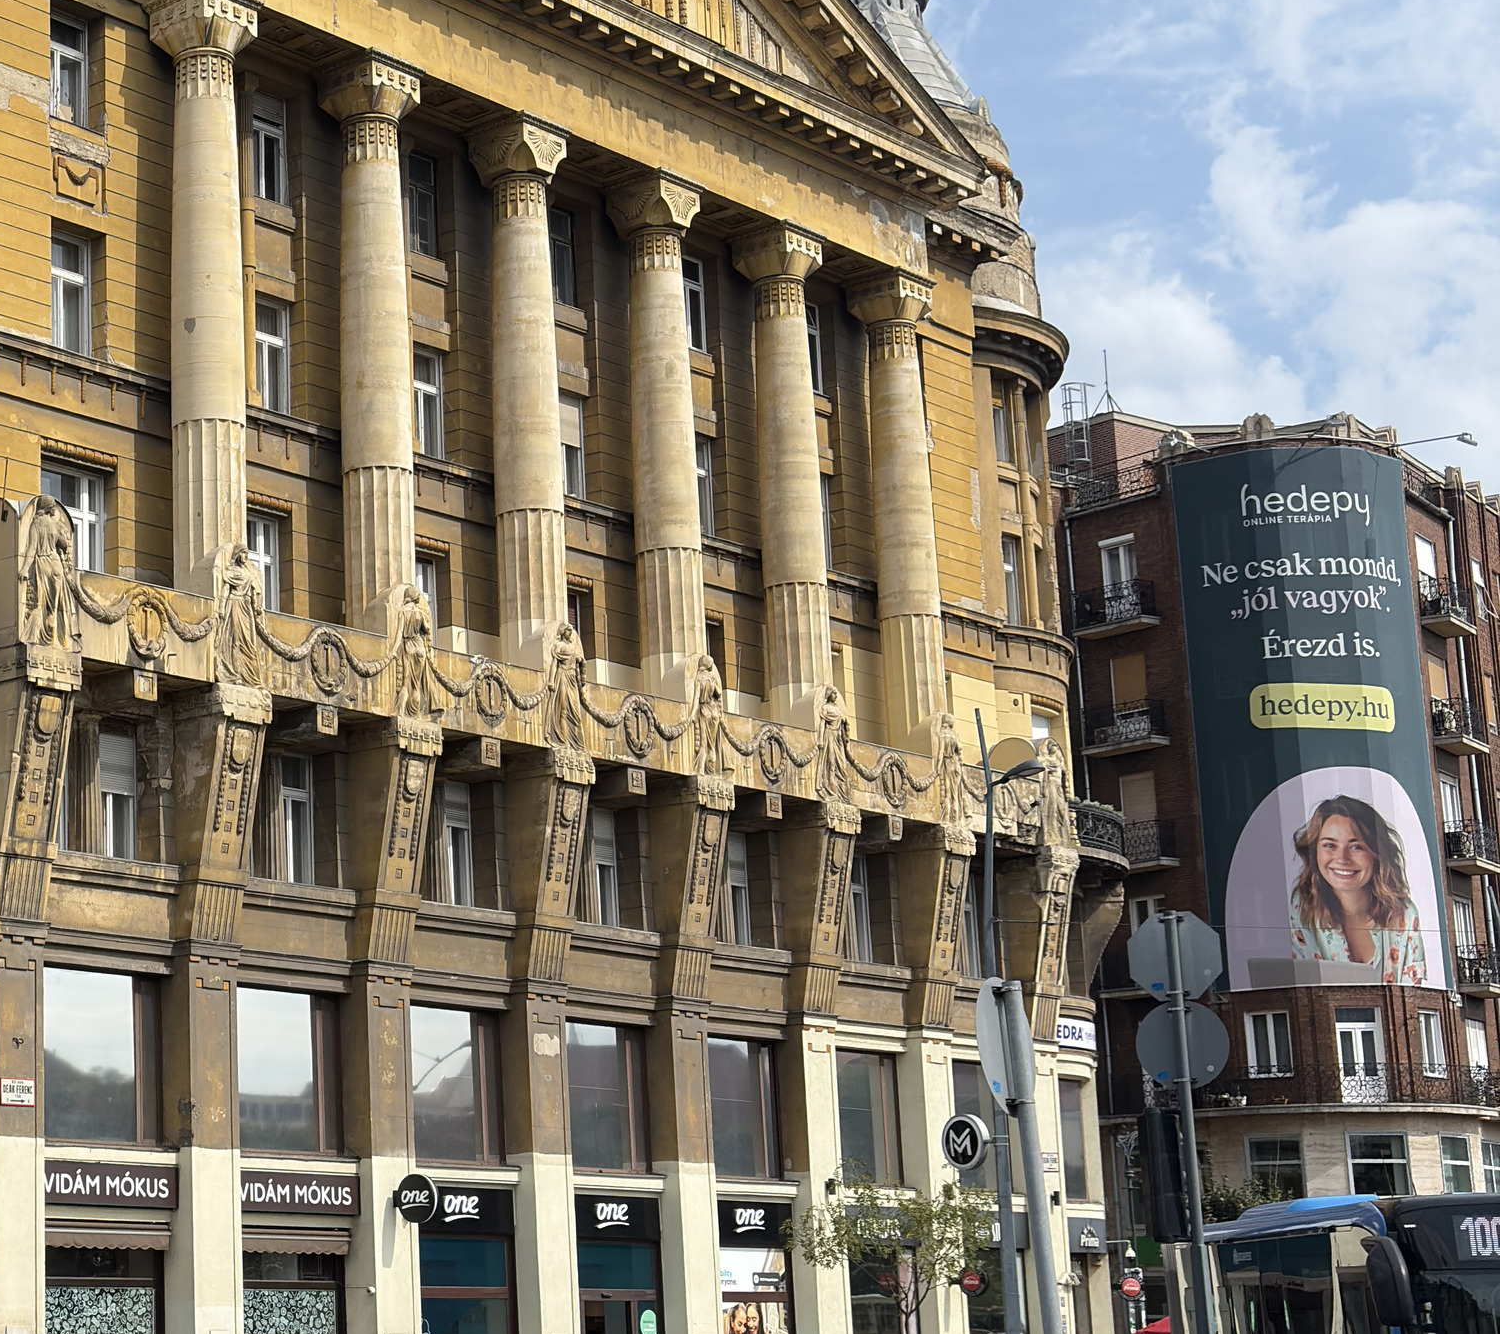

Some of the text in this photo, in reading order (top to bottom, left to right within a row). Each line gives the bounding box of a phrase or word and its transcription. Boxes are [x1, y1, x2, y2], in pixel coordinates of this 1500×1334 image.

[1240, 483, 1370, 526] hedepy
[1243, 513, 1332, 527] ONLINE TERÁPIA
[1201, 552, 1402, 588] Ne csak mondd,
[1230, 586, 1279, 620] „jól
[1261, 629, 1381, 659] Érezd is.
[1259, 694, 1390, 722] hedepy.hu
[1056, 1024, 1083, 1041] EDRA
[44, 1169, 170, 1199] VIDÁM MÓKUS
[240, 1178, 352, 1206] VIDÁM MÓKUS
[401, 1189, 430, 1204] one
[443, 1194, 479, 1214] one
[596, 1202, 629, 1221] one
[735, 1208, 765, 1226] one
[1080, 1234, 1100, 1248] Prima
